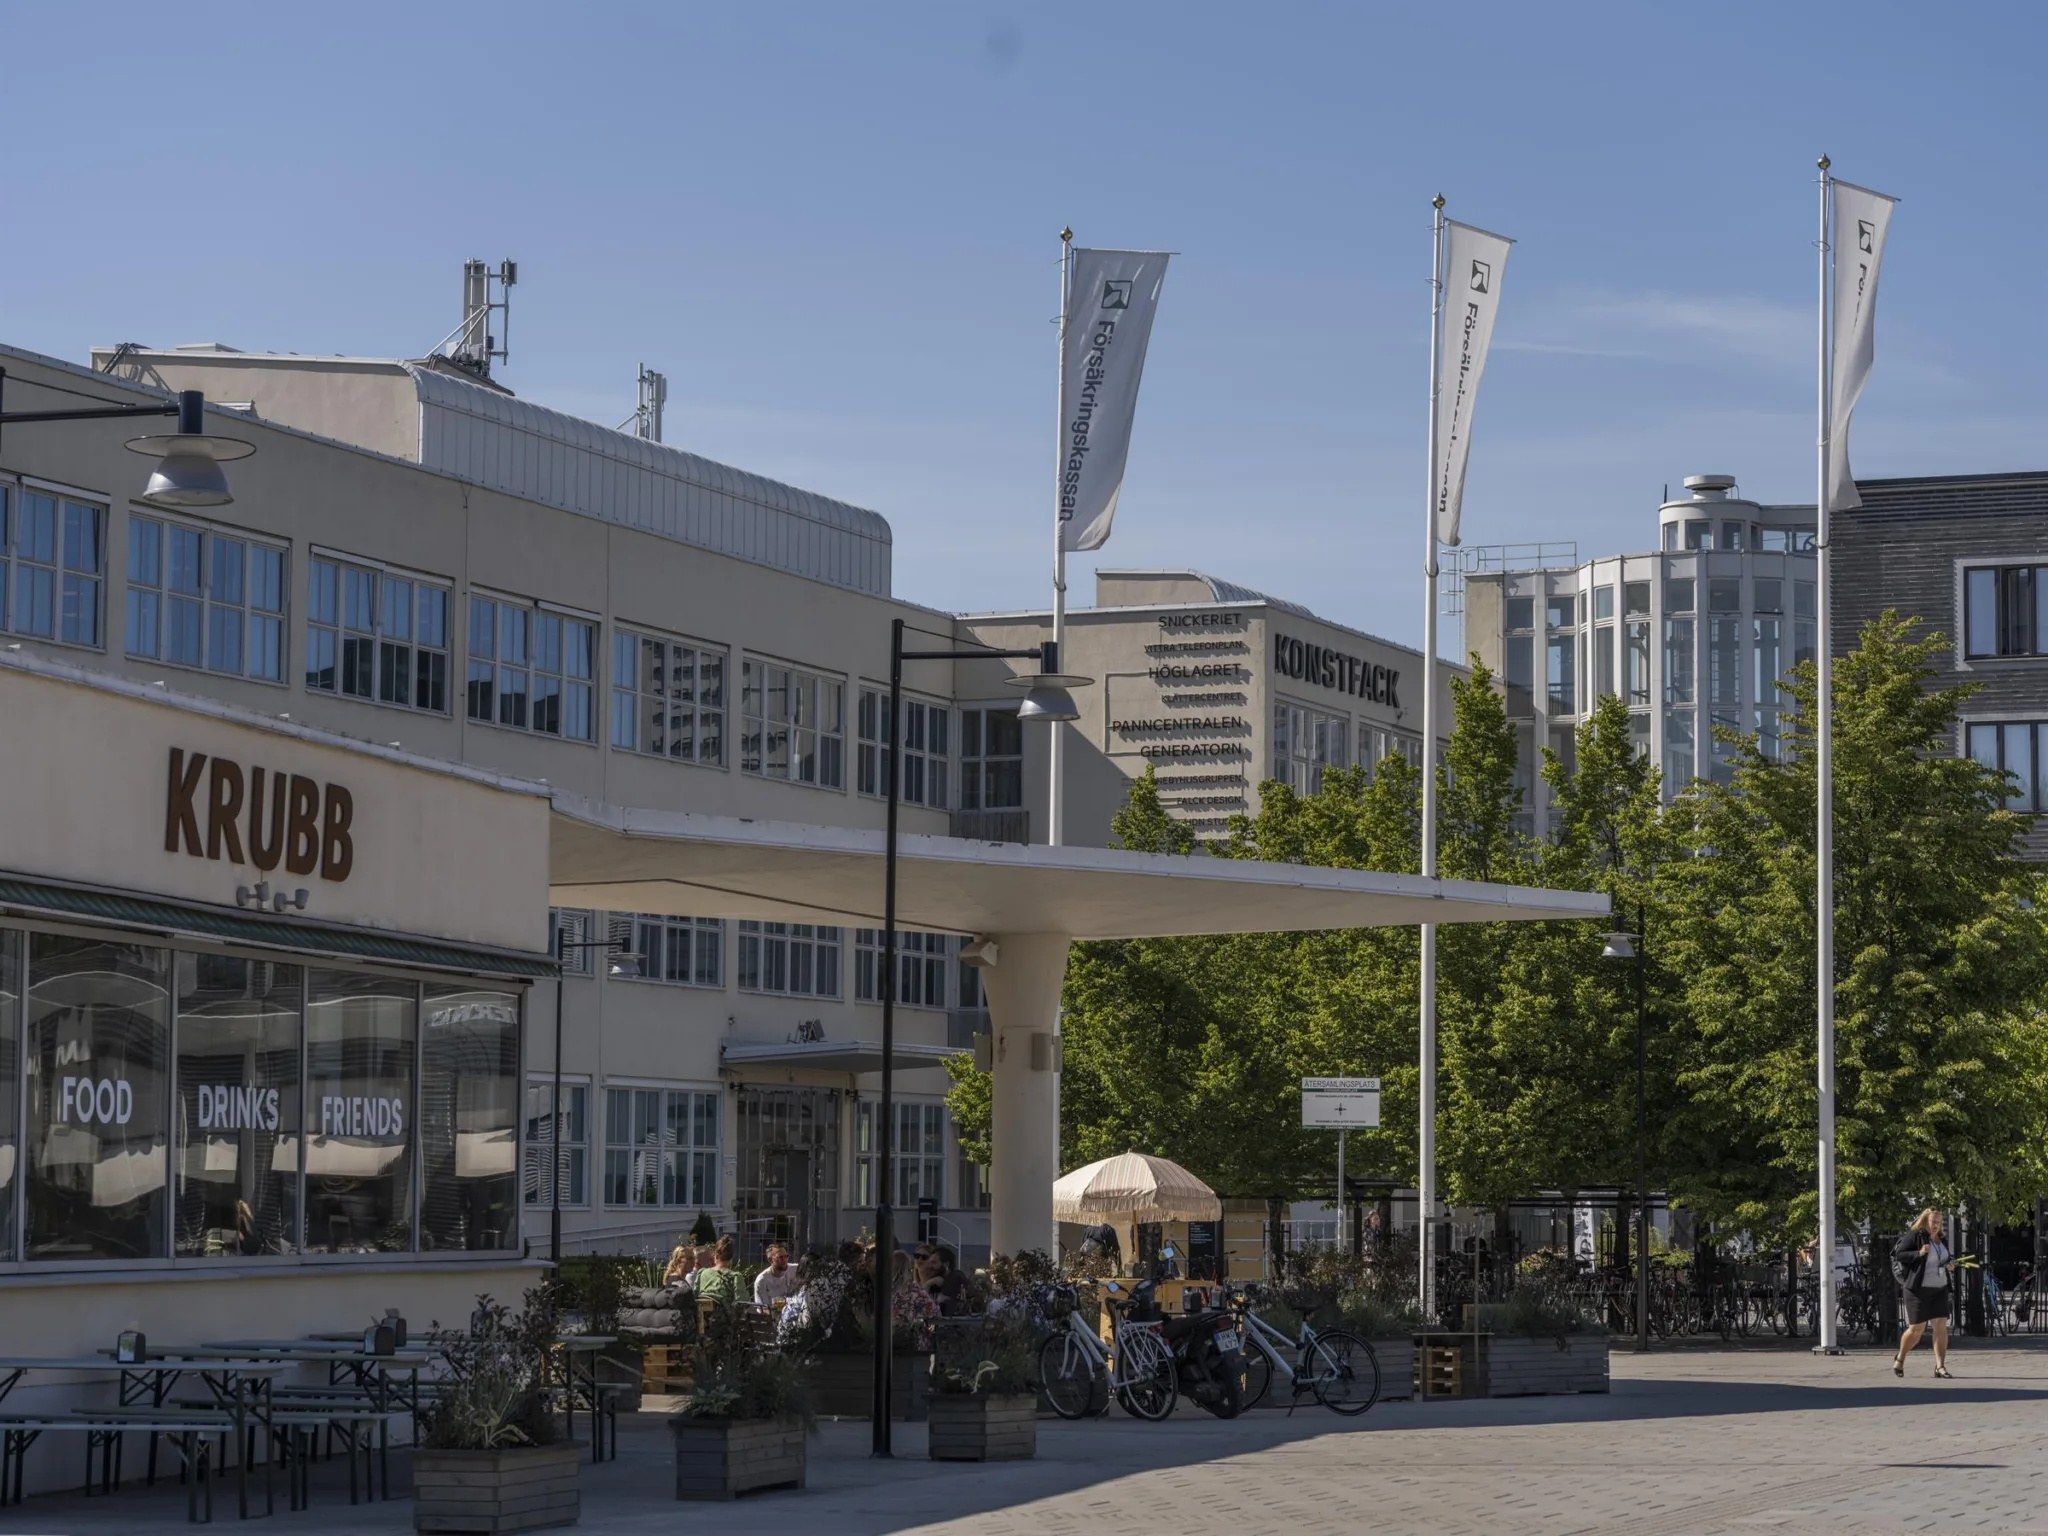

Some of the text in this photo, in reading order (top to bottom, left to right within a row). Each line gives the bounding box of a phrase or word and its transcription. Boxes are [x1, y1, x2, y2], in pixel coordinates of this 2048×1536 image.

[1059, 320, 1115, 522] Försäkringskassan
[1158, 613, 1242, 628] SNICKERIET
[1144, 641, 1242, 653] VITTRA TELEFONPLAN
[1149, 663, 1242, 679] HÖGLAGRET
[1274, 633, 1400, 708] KONSTFACK
[1161, 692, 1242, 703] KLÄTTERCENTRET
[1112, 716, 1242, 733] PANNCENTRALEN
[1140, 742, 1242, 758] GENERATORN
[1155, 774, 1242, 785] NEBYHUSGRUPPEN
[1176, 796, 1242, 805] FALCK DESIGN
[165, 747, 353, 882] KRUBB
[1304, 1079, 1376, 1088] ÅTERSAMLINGSPLATS
[62, 1076, 133, 1124] FOOD
[198, 1085, 279, 1131] DRINKS
[322, 1096, 403, 1136] FRIENDS
